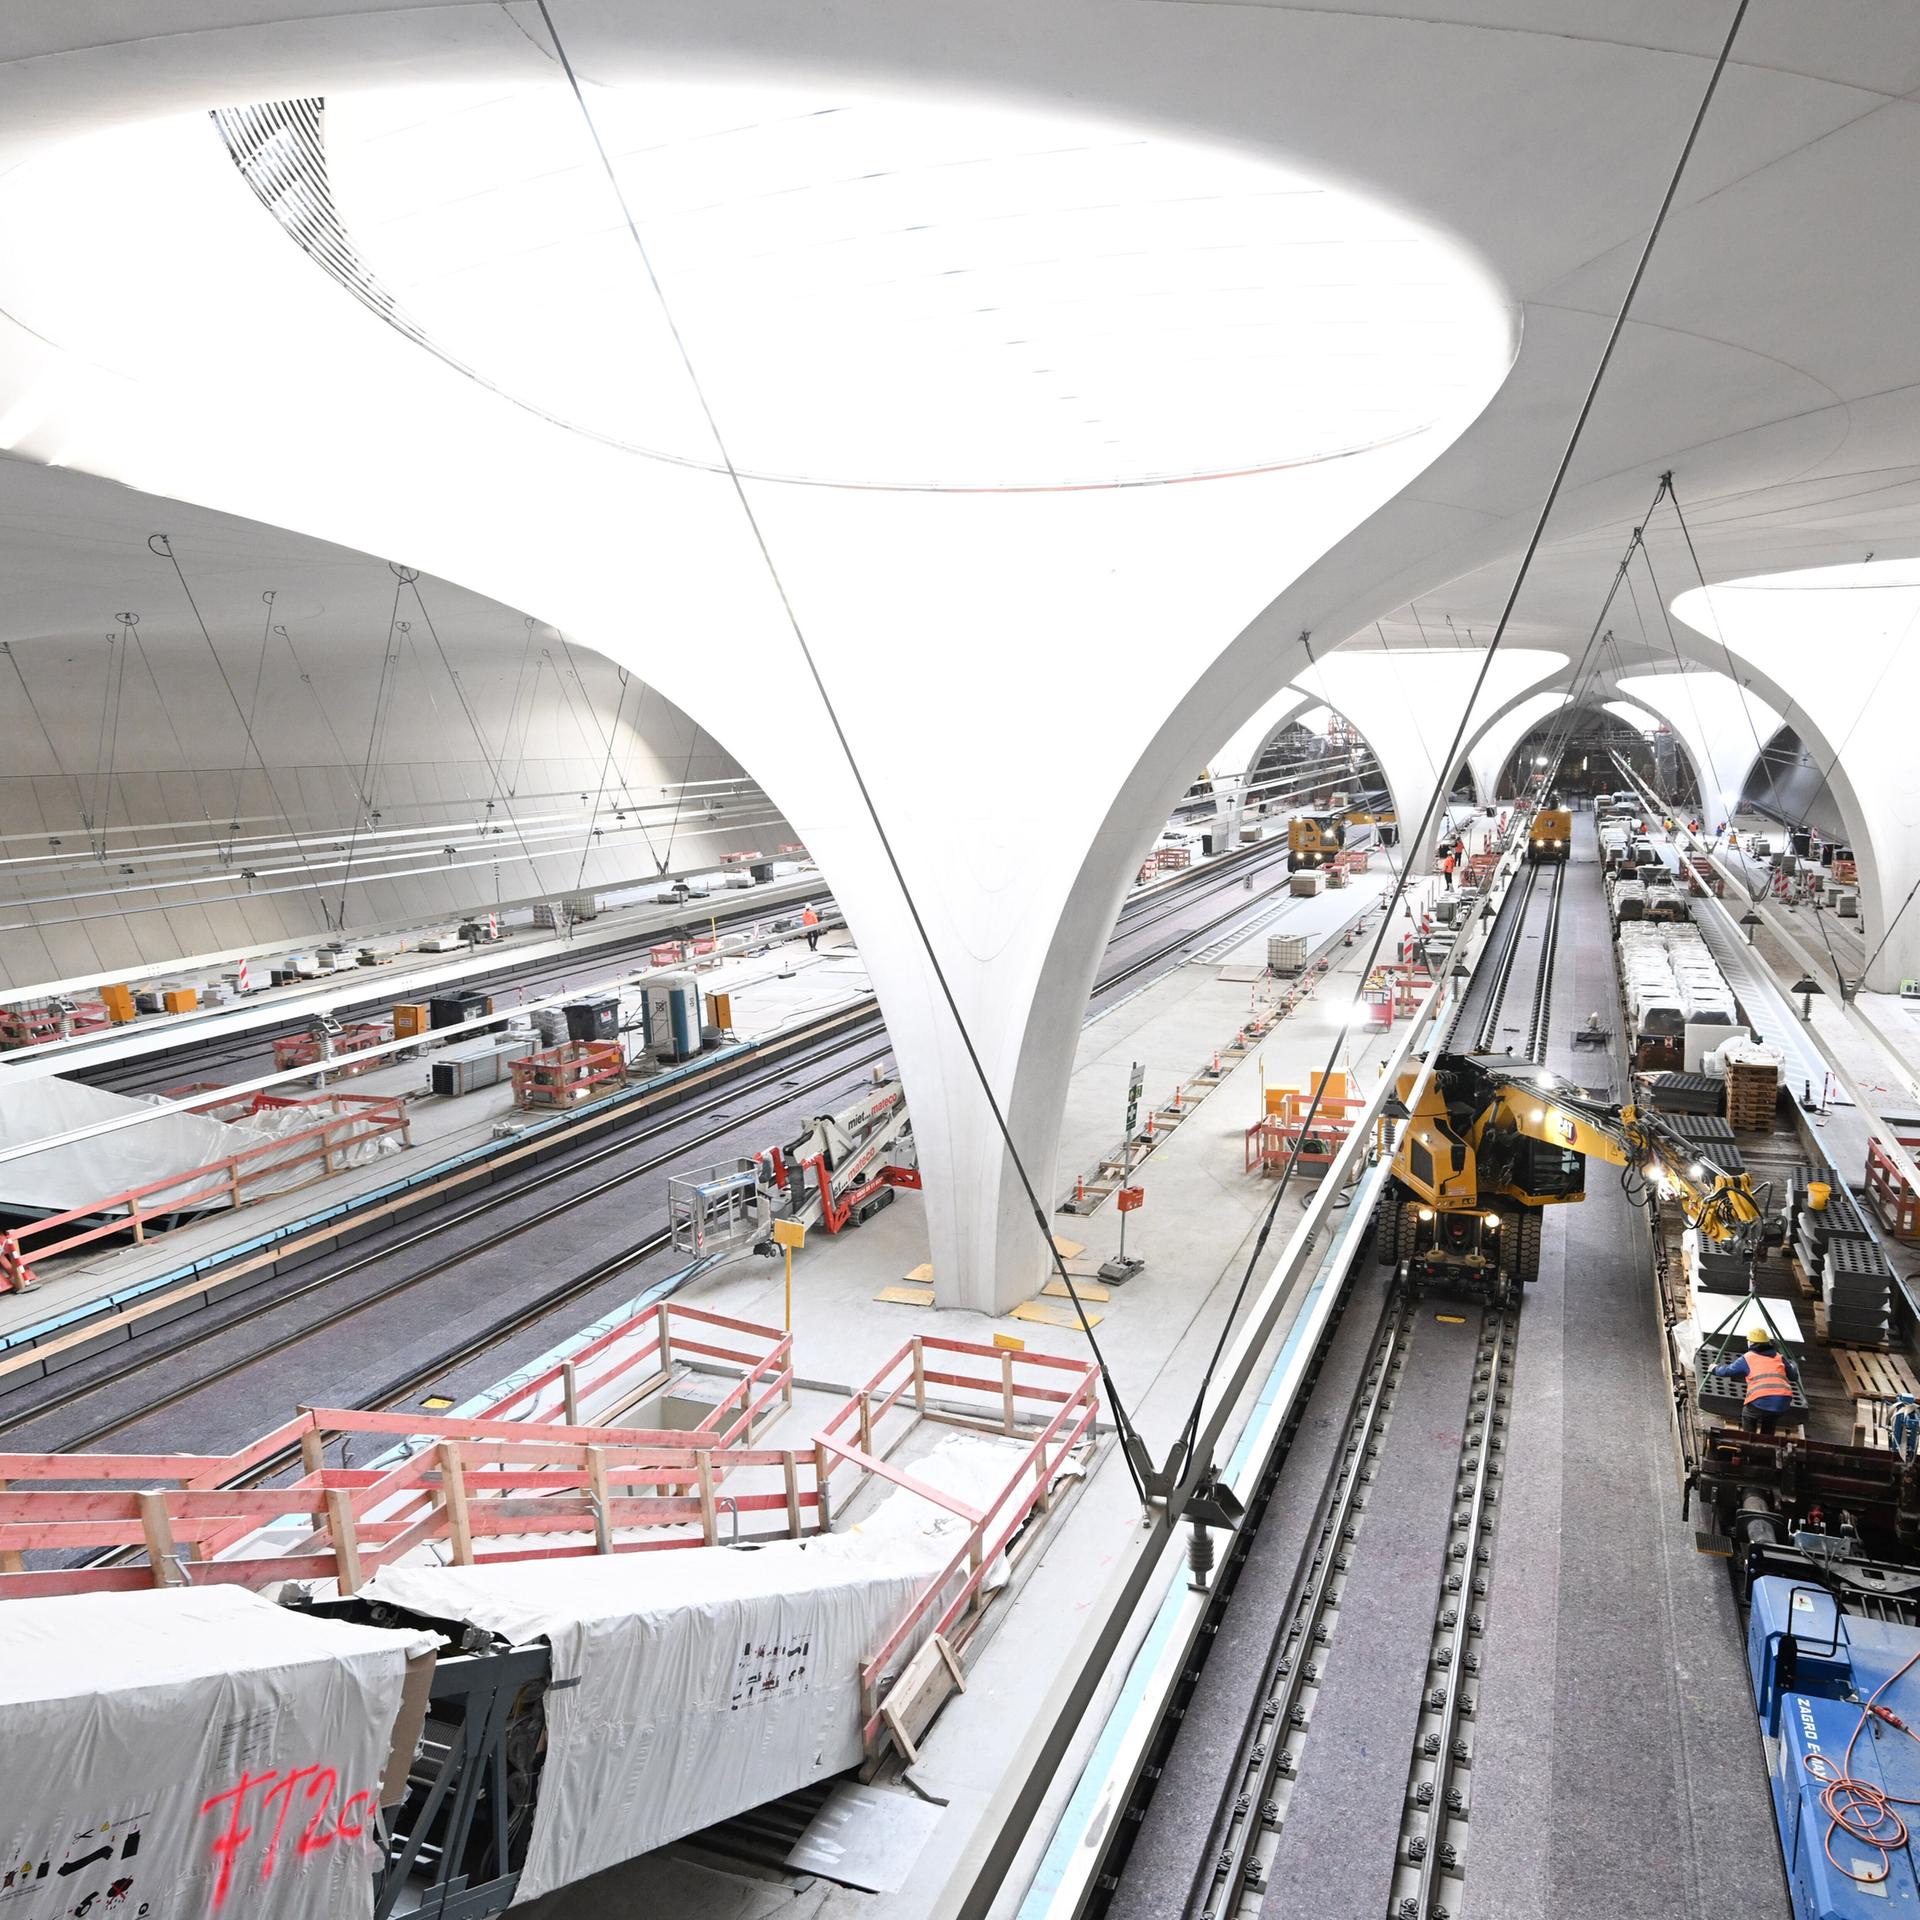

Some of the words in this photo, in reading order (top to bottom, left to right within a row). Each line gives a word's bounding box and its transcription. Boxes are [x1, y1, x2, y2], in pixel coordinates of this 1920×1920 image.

[871, 1093, 897, 1115] mateco
[848, 1147, 875, 1180] mateco
[1797, 1697, 1818, 1740] ZAGRO
